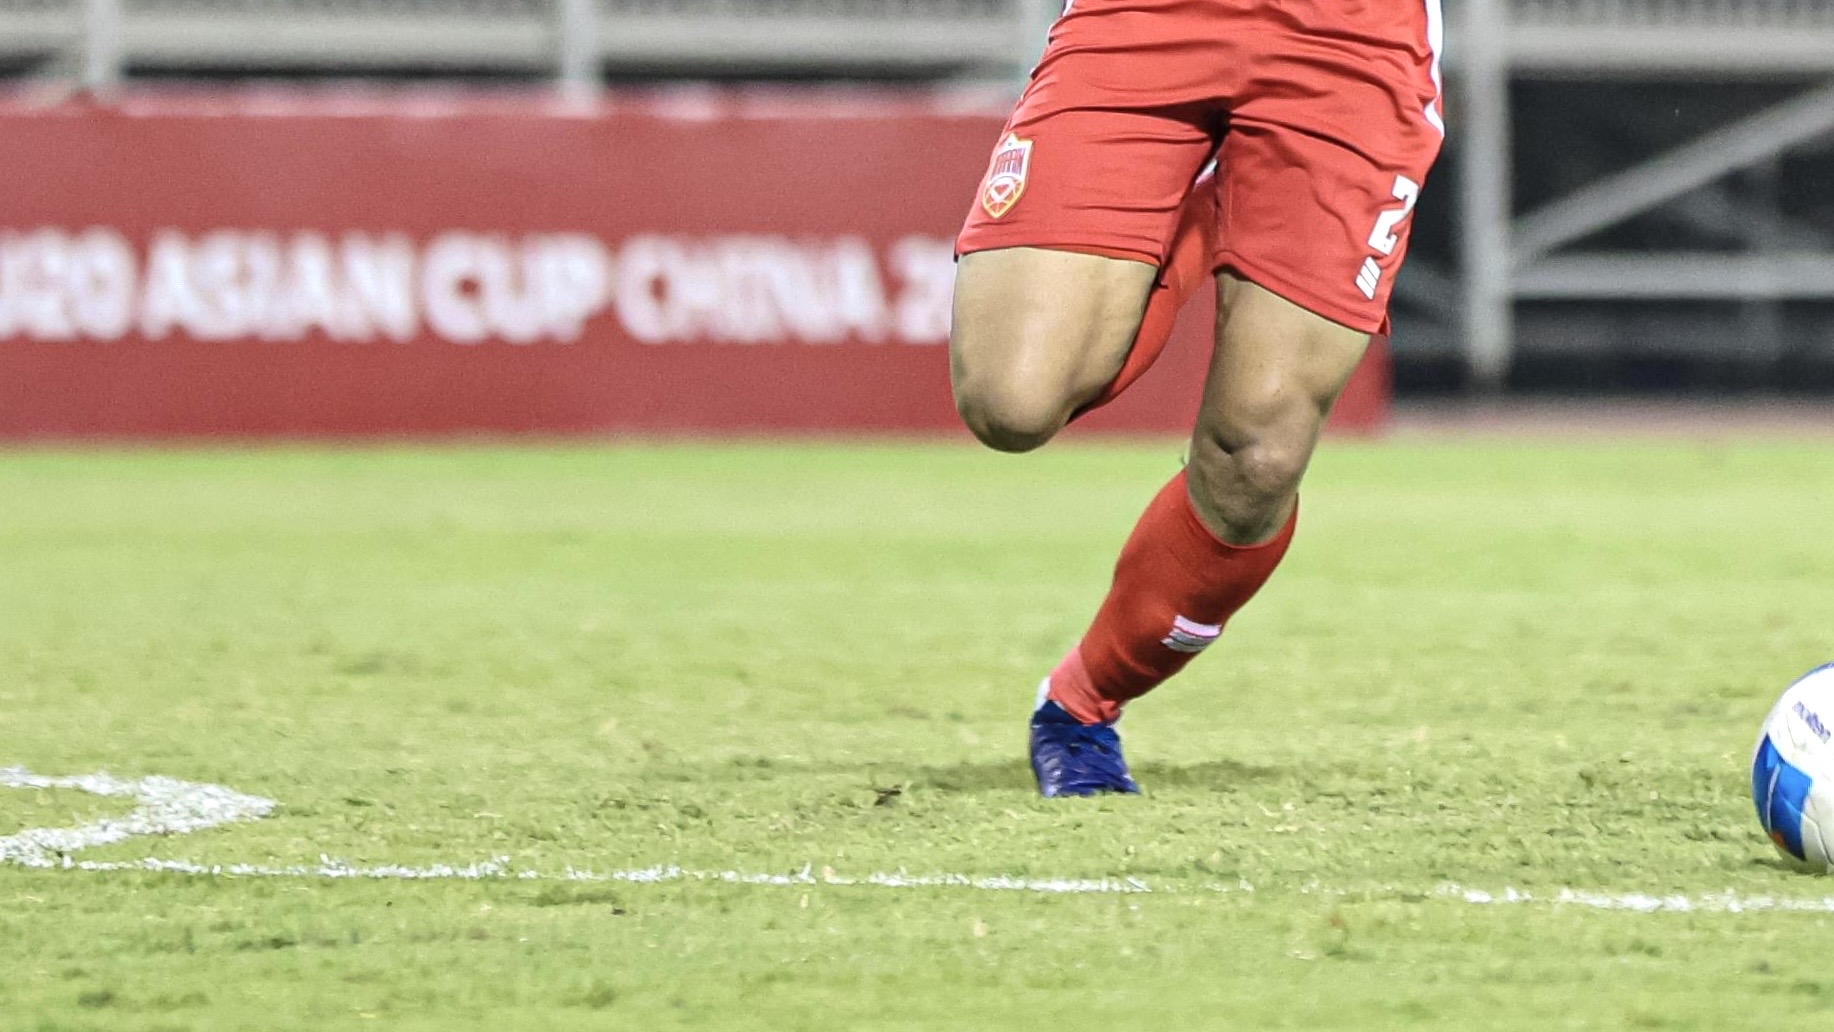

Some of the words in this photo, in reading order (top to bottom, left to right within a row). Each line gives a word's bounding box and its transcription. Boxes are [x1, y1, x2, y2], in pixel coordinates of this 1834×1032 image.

[1368, 175, 1420, 255] 2
[141, 230, 417, 341] ASIAN
[422, 233, 609, 342] CUP
[614, 234, 889, 343] CHINA
